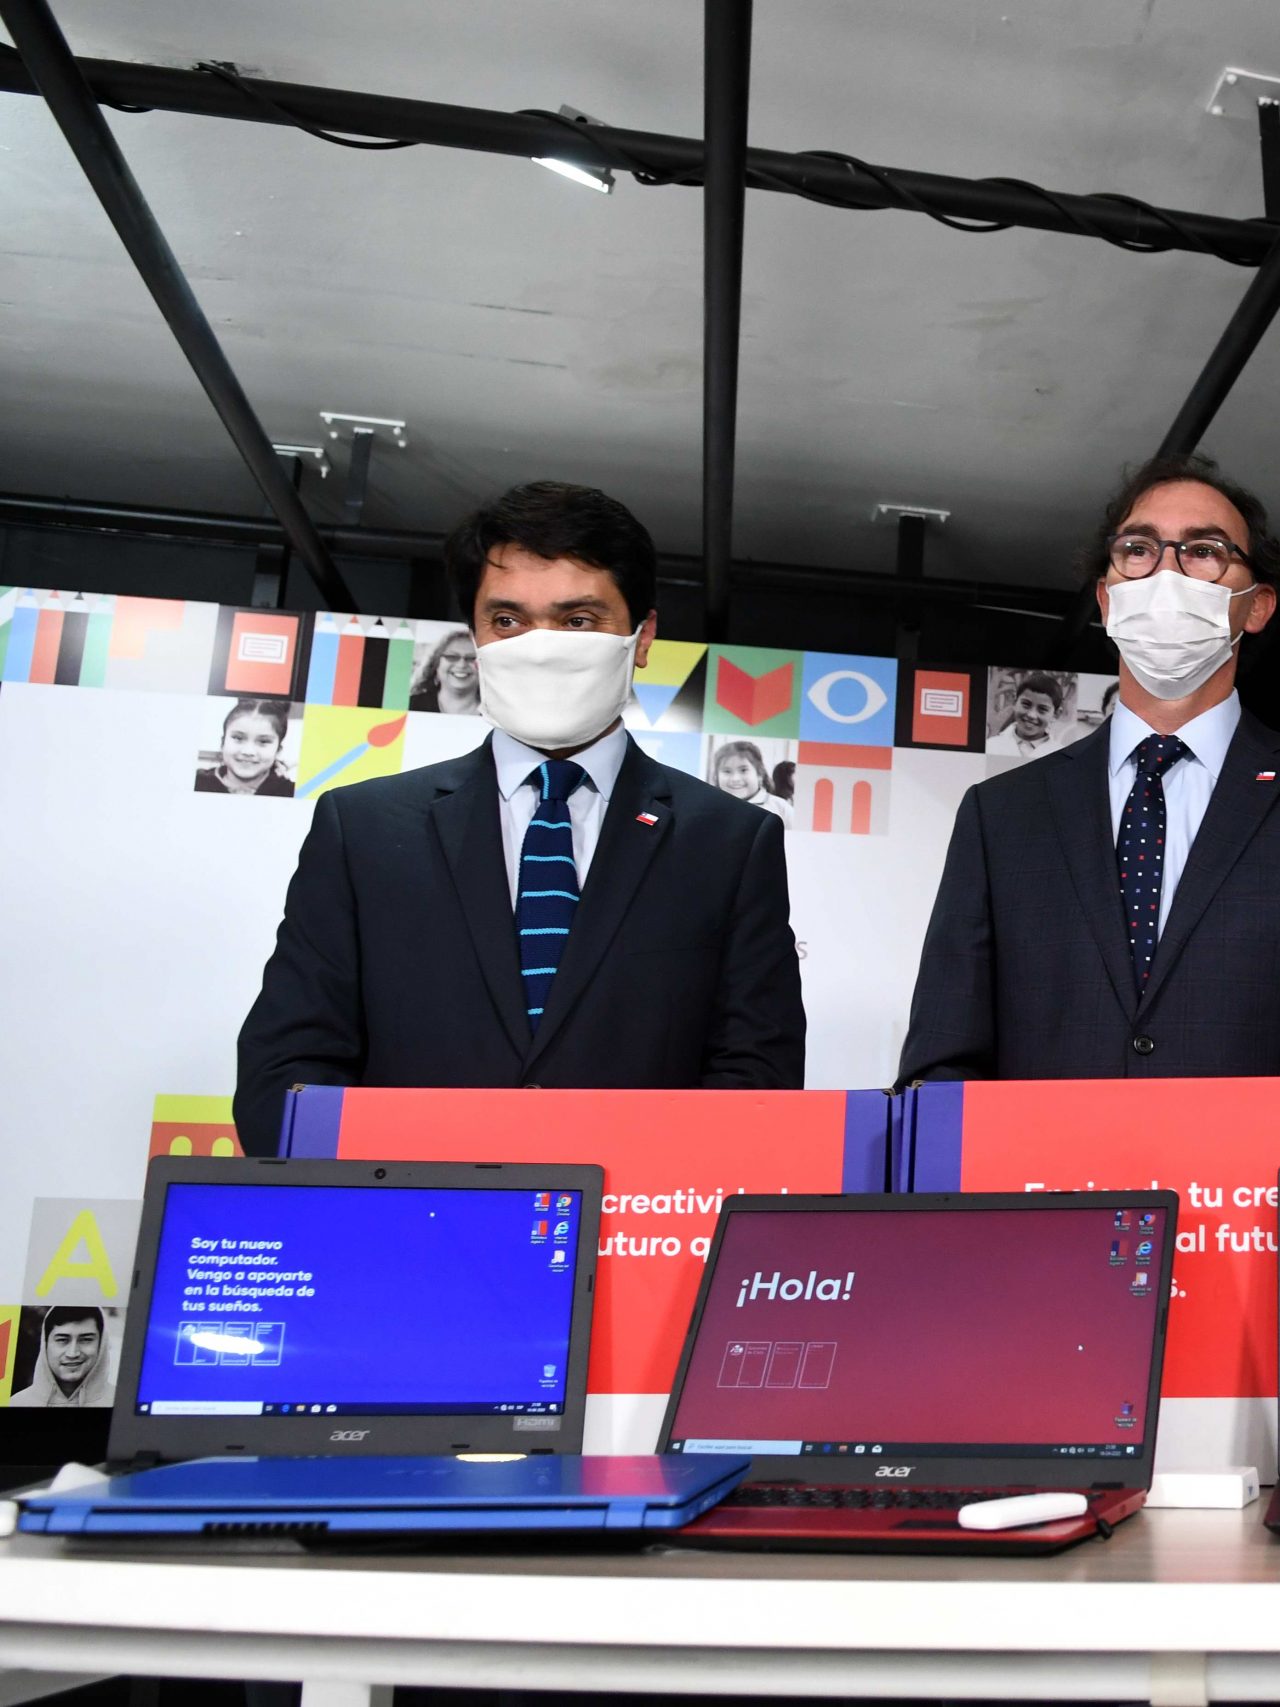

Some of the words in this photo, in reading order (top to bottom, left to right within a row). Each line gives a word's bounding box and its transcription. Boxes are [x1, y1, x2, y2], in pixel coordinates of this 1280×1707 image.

[601, 1187, 788, 1214] creativi
[1188, 1181, 1222, 1208] tu
[190, 1237, 219, 1251] Soy
[221, 1238, 237, 1249] tu
[239, 1240, 283, 1250] nuevo
[1175, 1224, 1205, 1252] al
[188, 1254, 279, 1267] computador.
[187, 1268, 232, 1283] Vengo
[235, 1271, 245, 1280] a
[247, 1270, 313, 1283] apoyarte
[184, 1286, 203, 1296] en
[205, 1284, 219, 1296] la
[222, 1284, 294, 1299] búsqueda
[296, 1285, 315, 1297] de
[736, 1270, 855, 1307] ¡Hola!
[182, 1300, 205, 1311] tus
[208, 1300, 263, 1312] sueños.
[329, 1429, 371, 1441] acer
[874, 1465, 916, 1478] acer
